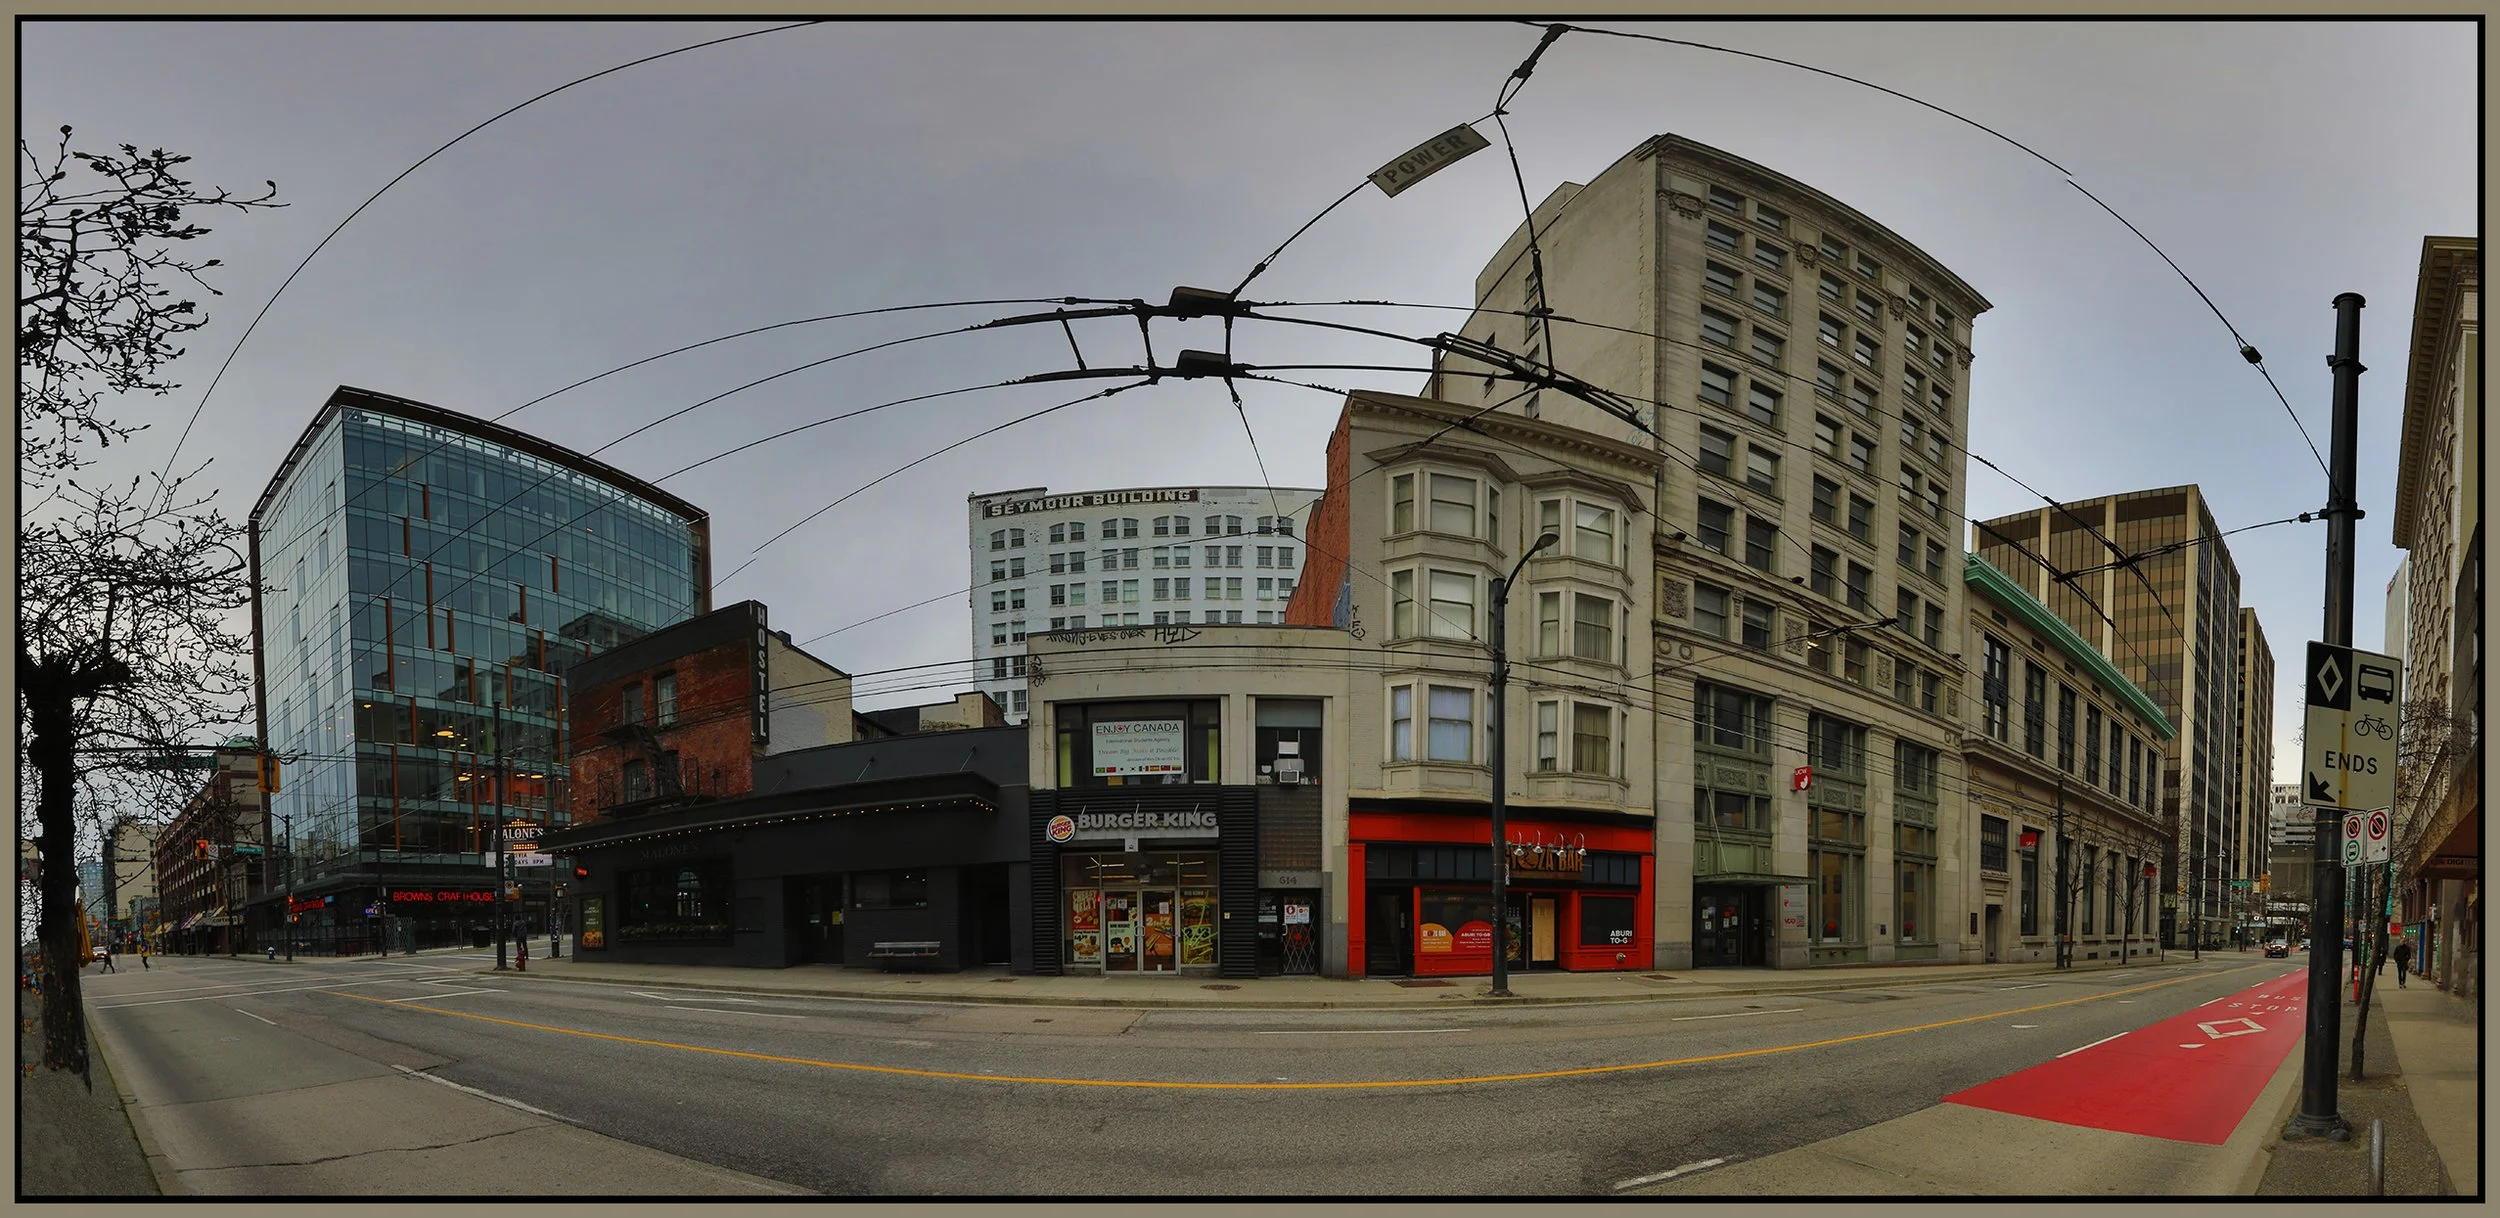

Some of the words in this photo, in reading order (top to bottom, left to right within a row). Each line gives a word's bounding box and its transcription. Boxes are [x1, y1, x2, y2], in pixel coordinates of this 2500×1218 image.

[1383, 134, 1468, 185] POWER
[991, 496, 1085, 517] SEYMOUR
[1092, 490, 1191, 506] BUILDING
[756, 605, 768, 738] HOSTEL
[1096, 724, 1132, 734] ENJOY
[1133, 722, 1180, 734] CANADA
[2325, 750, 2378, 775] ENDS
[1051, 820, 1071, 830] BURGER
[1077, 812, 1159, 830] BURGER
[1162, 811, 1218, 828] KING
[1052, 825, 1073, 836] KING
[1279, 876, 1297, 885] 614
[393, 891, 433, 902] BROWNS
[2257, 993, 2302, 1001] BUS
[2228, 1001, 2298, 1012] STOP
